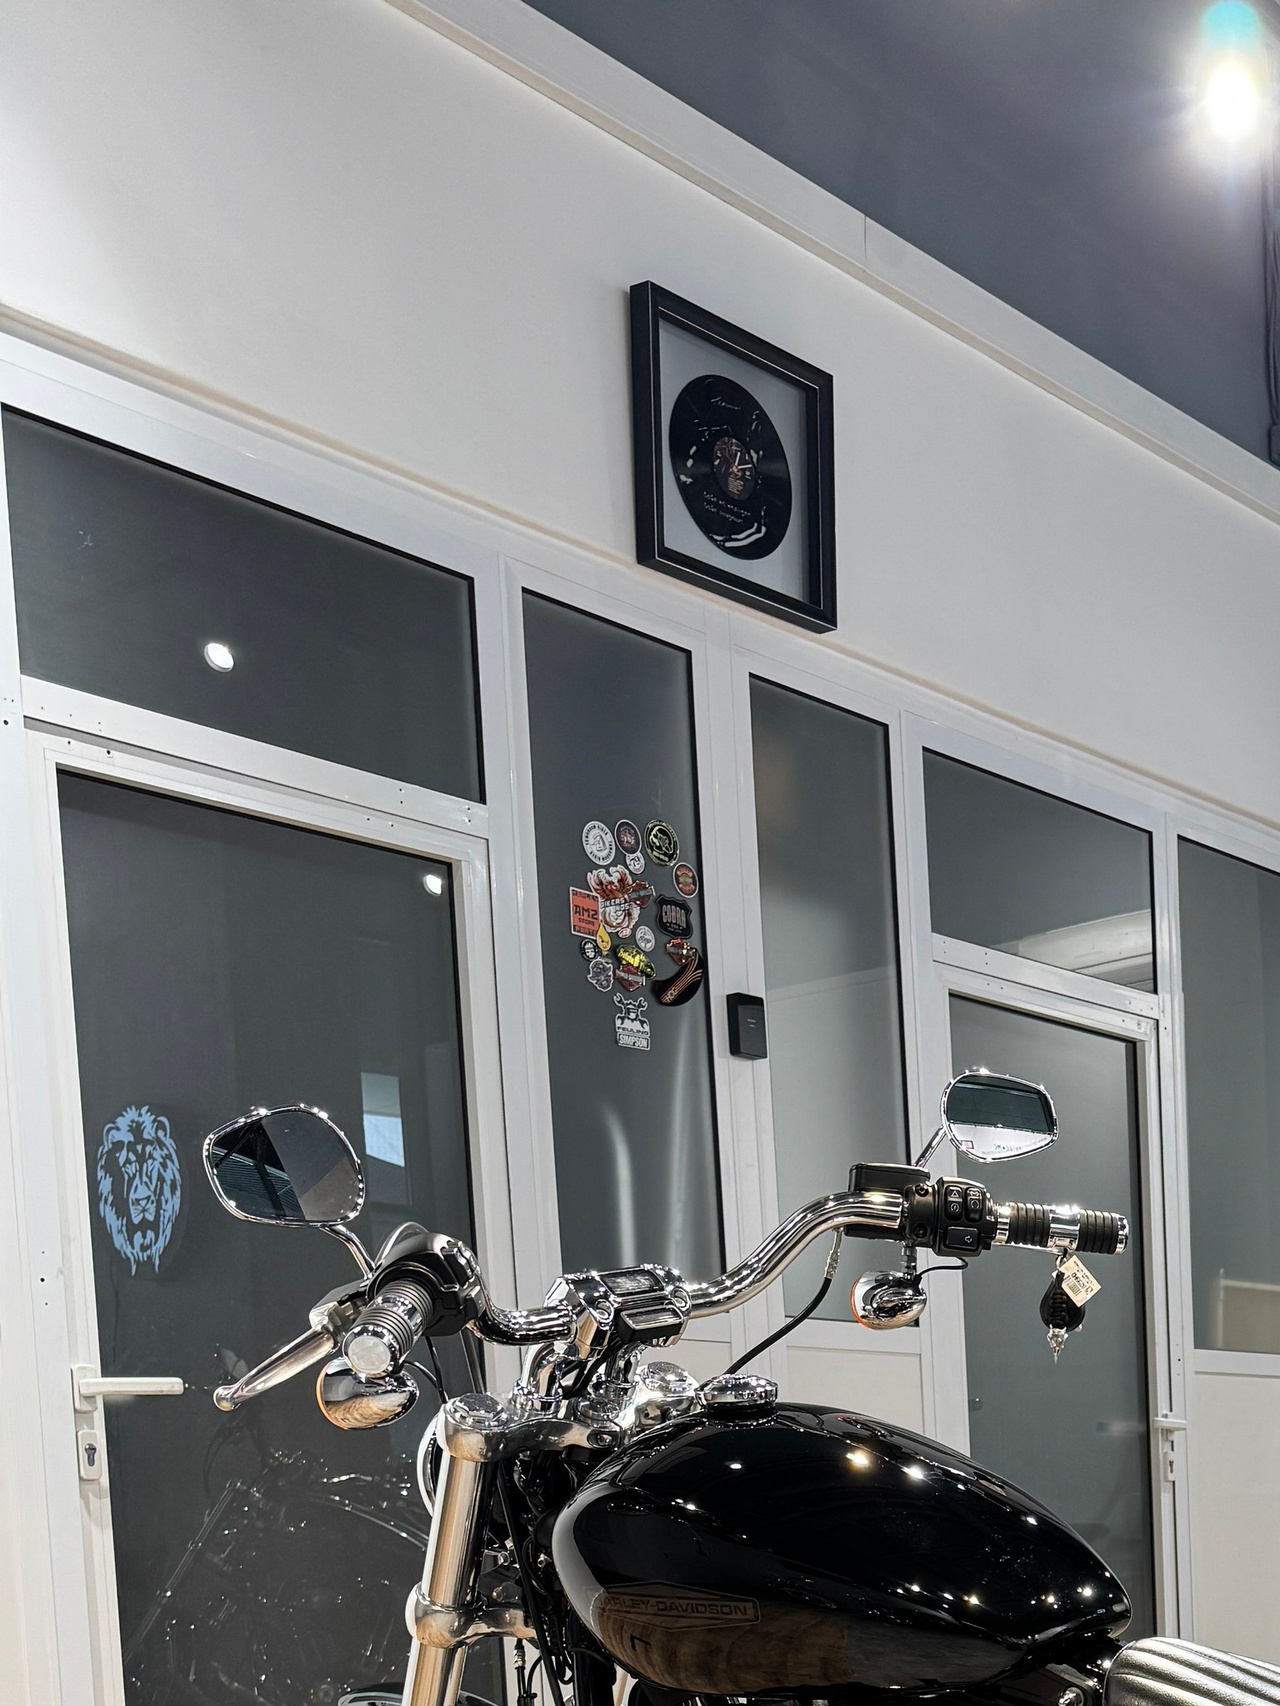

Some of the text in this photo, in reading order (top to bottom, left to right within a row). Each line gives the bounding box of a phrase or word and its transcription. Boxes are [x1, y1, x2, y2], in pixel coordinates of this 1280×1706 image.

[662, 904, 687, 928] COBRA
[619, 1034, 648, 1048] SIMPSON
[598, 1596, 749, 1617] ARLEY-DAVIDSON
